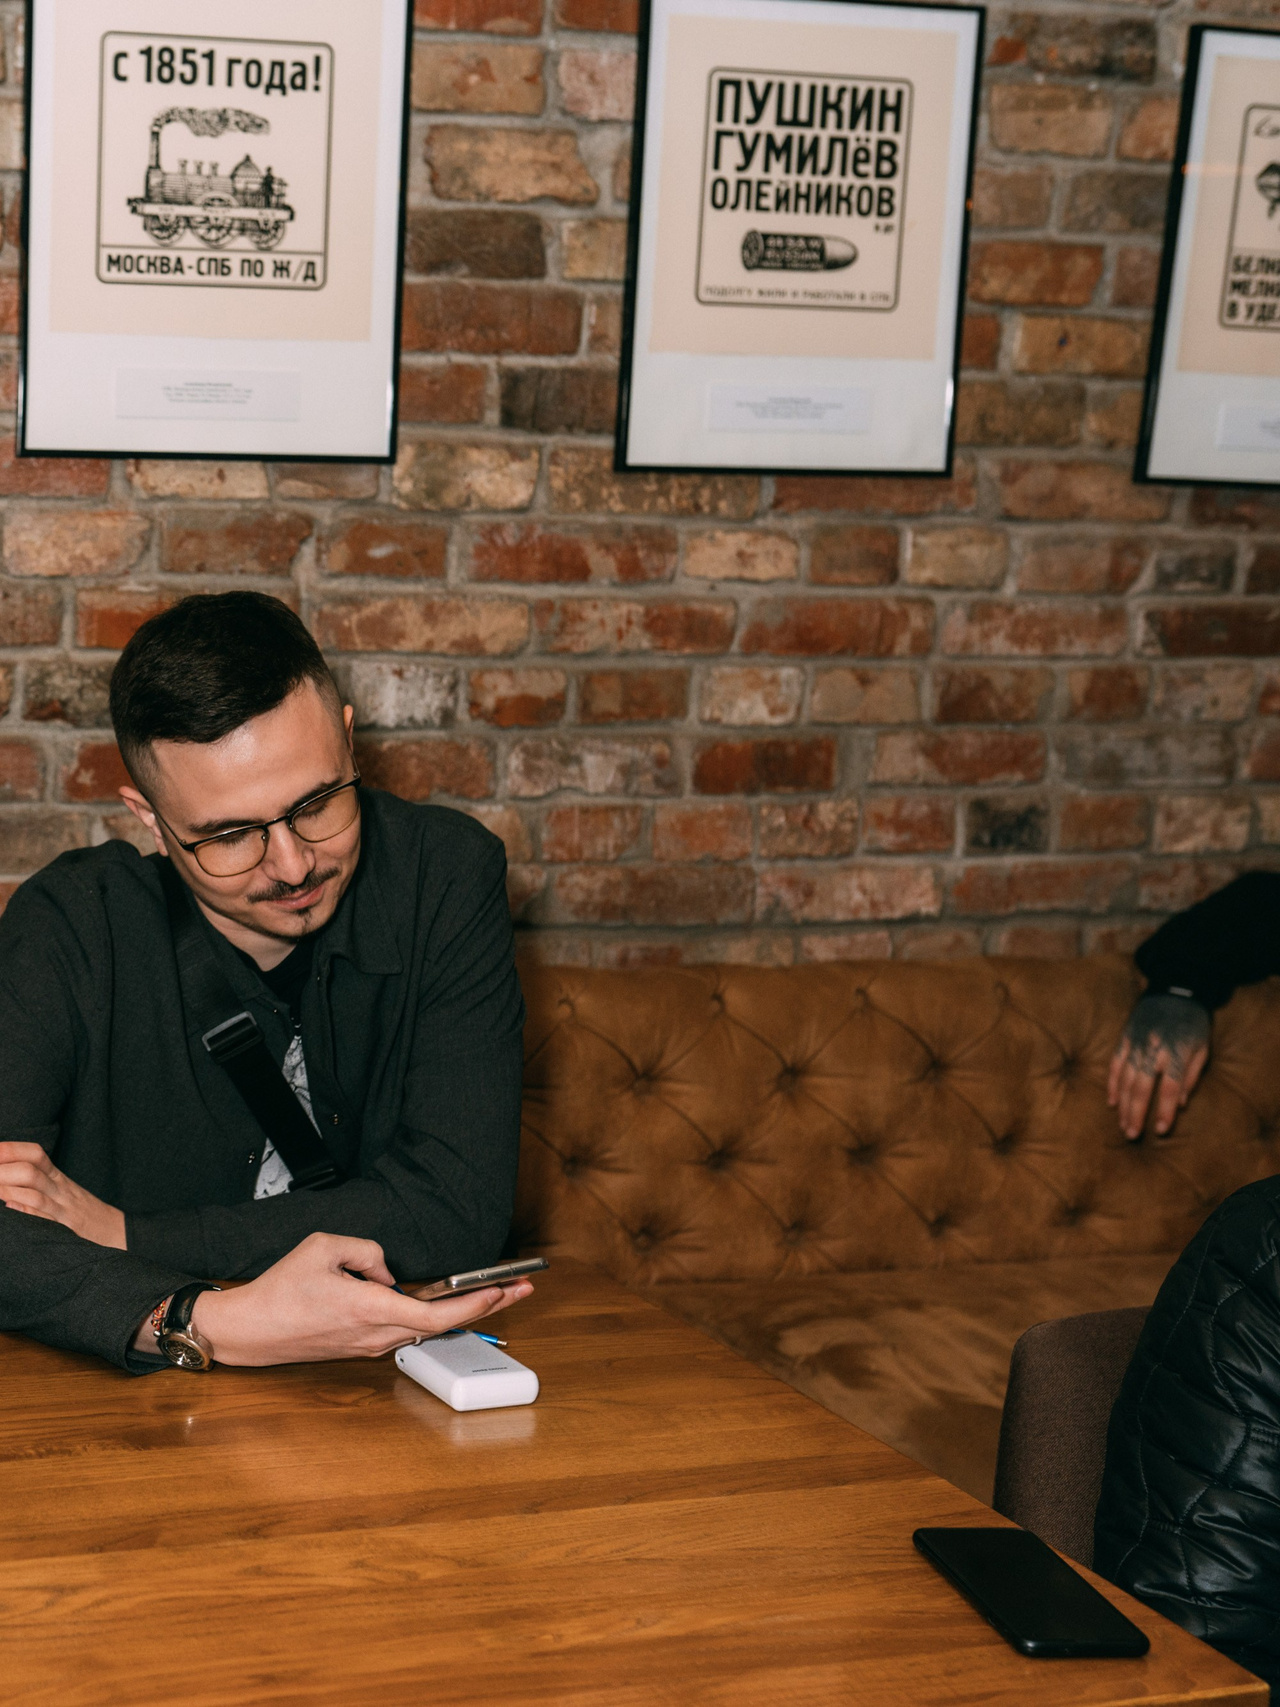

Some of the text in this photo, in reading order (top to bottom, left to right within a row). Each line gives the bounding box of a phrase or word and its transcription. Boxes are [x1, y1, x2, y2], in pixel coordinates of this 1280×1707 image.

[139, 46, 215, 86] 1851
[226, 55, 322, 96] года!
[716, 79, 904, 133] ПУШКИН
[240, 258, 264, 278] ПО
[272, 260, 317, 283] Ж/Д
